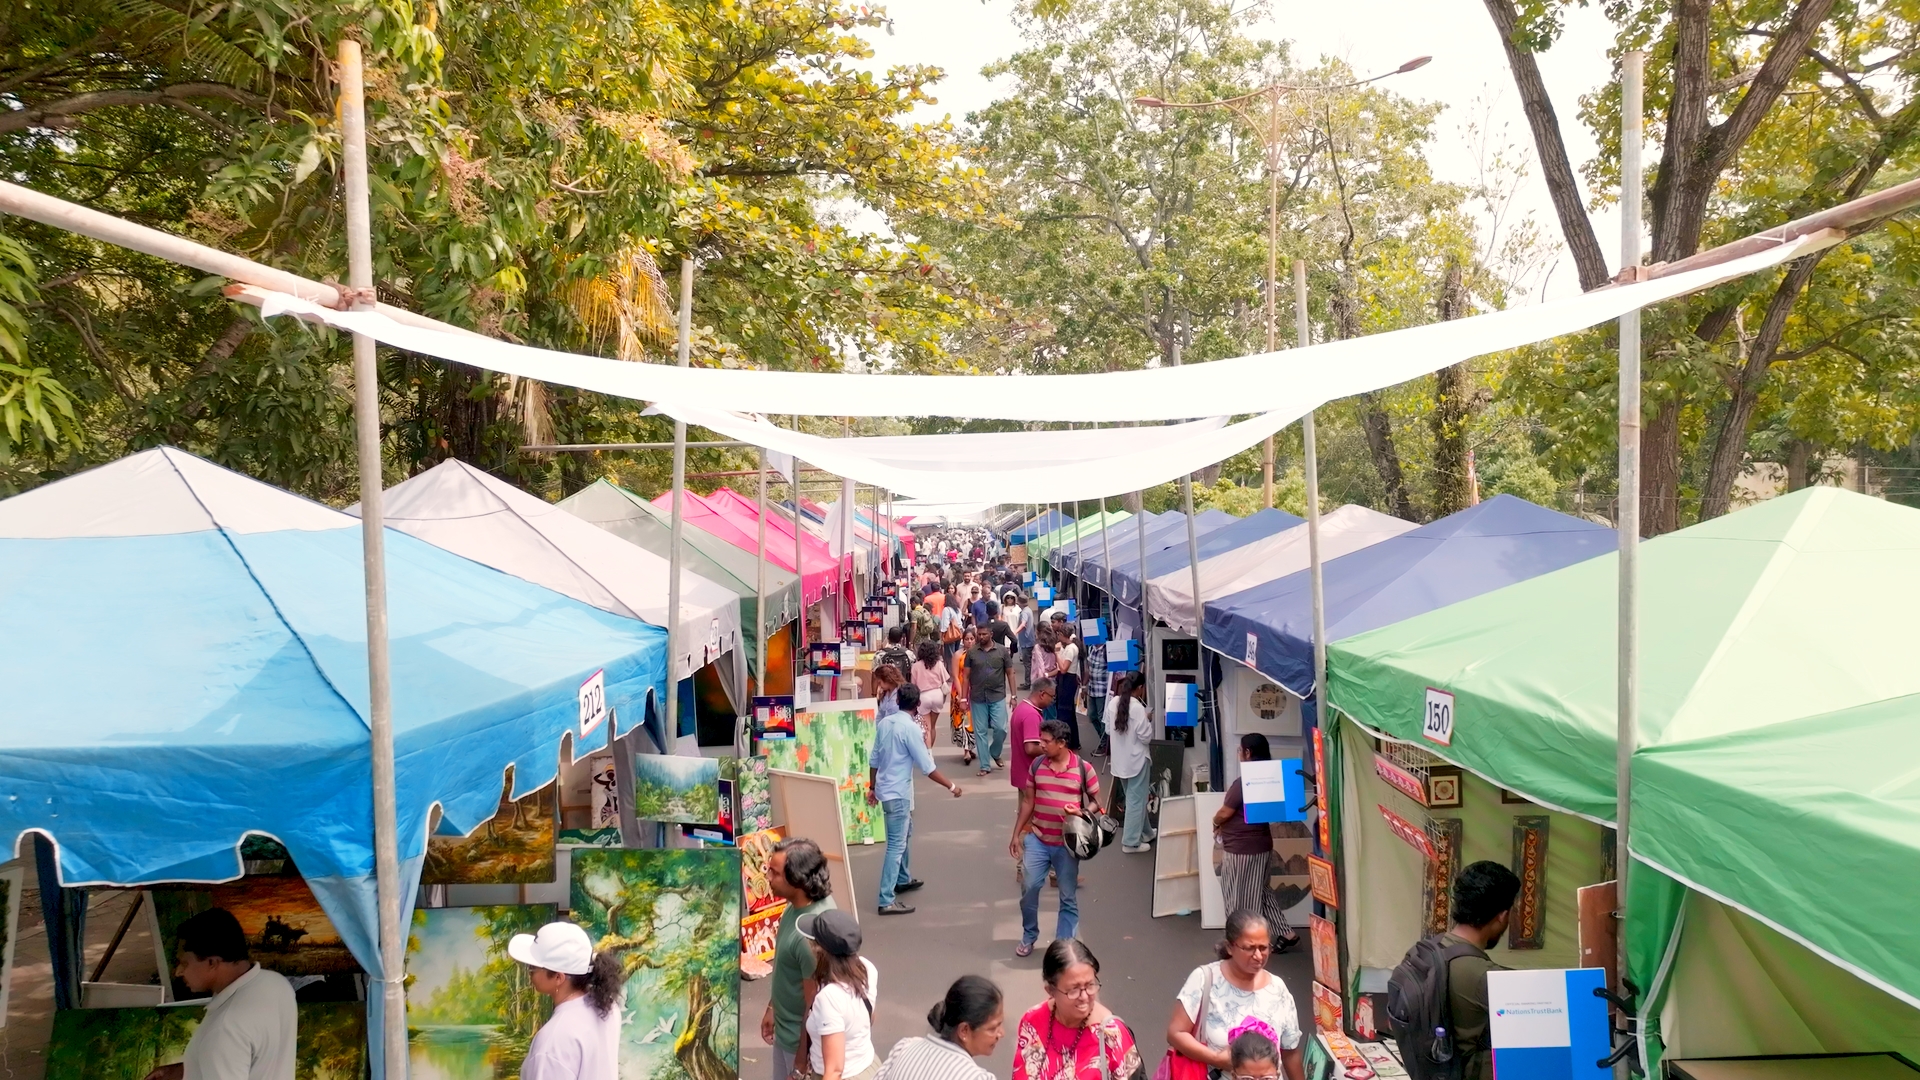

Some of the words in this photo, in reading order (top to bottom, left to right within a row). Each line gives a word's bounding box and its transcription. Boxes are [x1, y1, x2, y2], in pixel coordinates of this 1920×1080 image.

[583, 684, 603, 726] 212
[1427, 700, 1450, 735] 150
[1506, 1007, 1563, 1015] NationsTrustBank
